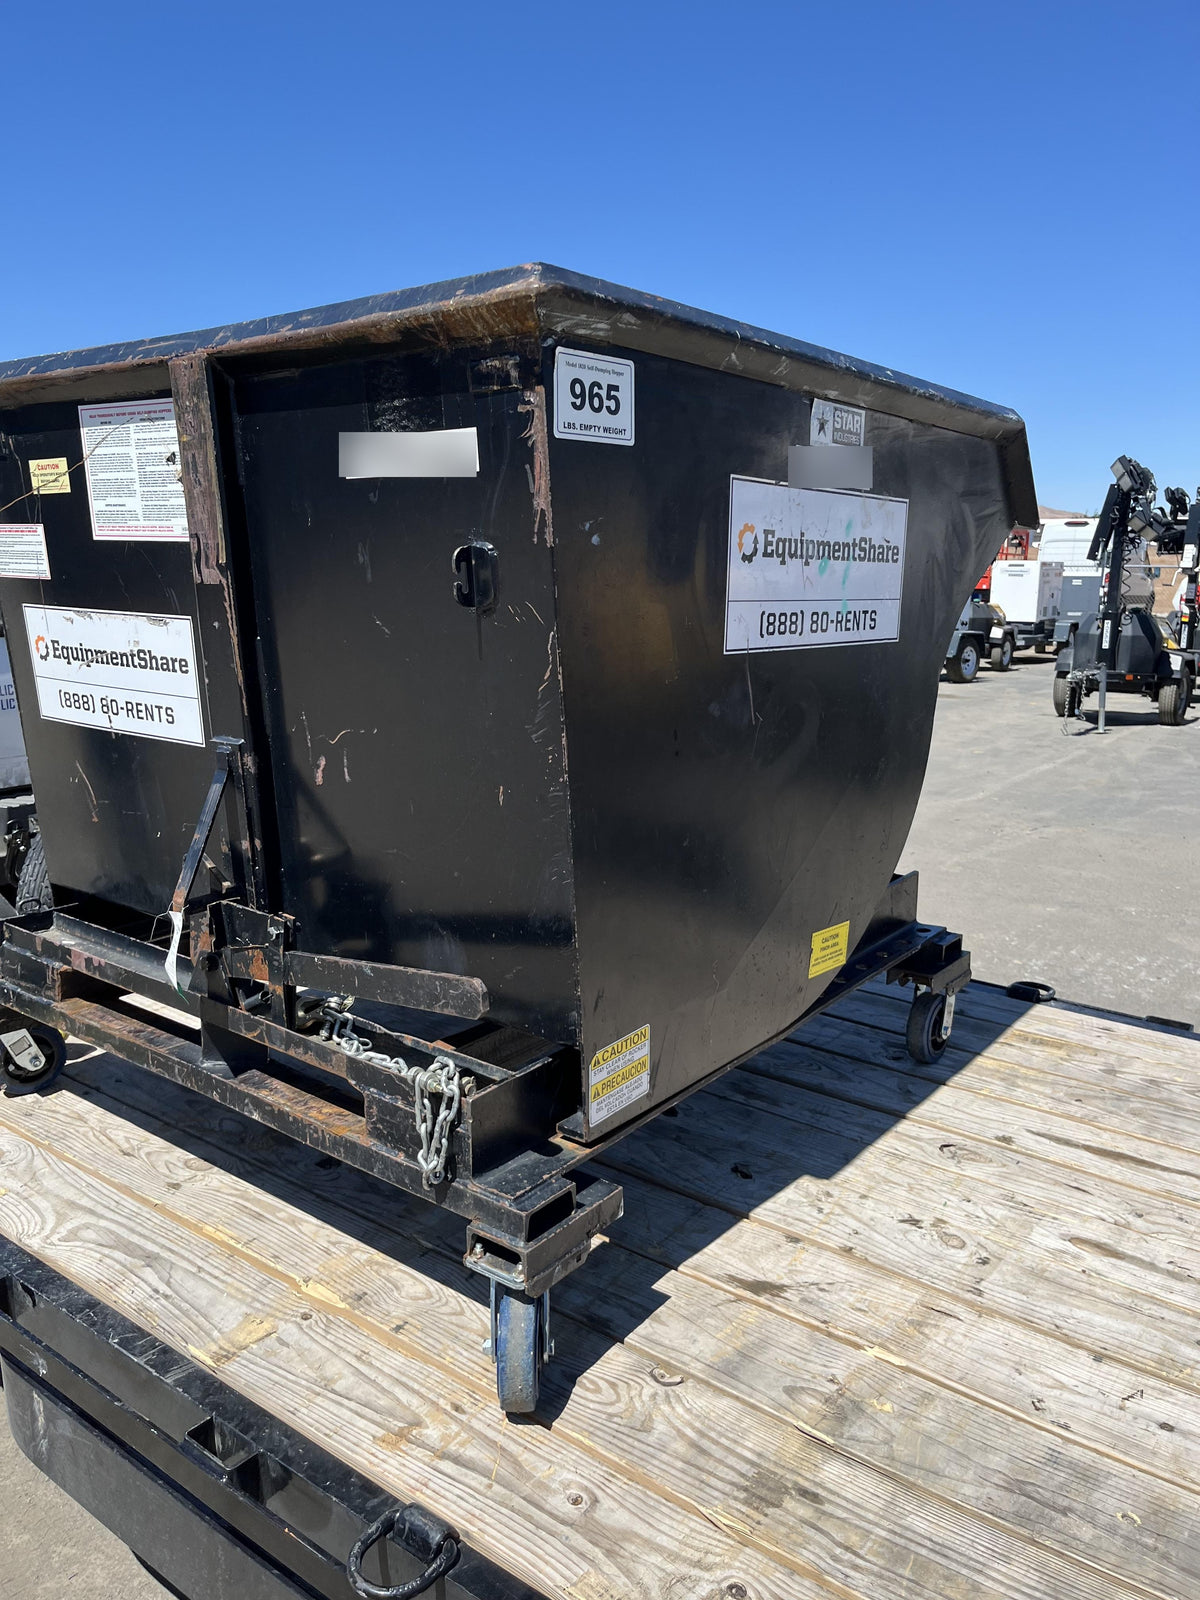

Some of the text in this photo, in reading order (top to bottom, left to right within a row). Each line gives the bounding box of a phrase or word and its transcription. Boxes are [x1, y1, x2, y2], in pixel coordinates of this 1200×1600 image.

[565, 360, 577, 369] Model
[569, 377, 621, 416] 965
[563, 421, 627, 436] LBS. EMPTY WEIGHT
[834, 410, 861, 433] STAR
[833, 431, 860, 445] INDUSTRIES
[37, 463, 60, 471] CAUTION
[762, 529, 900, 567] EquipmentShare
[759, 609, 877, 638] (888) 80-RENTS
[50, 639, 190, 675] EquipmentShare
[58, 689, 175, 725] (888) 80-RENTS
[593, 1042, 647, 1077] STAY CLEAR OF ROCKER
[602, 1028, 647, 1062] CAUTION
[606, 1055, 635, 1076] WHEN USING
